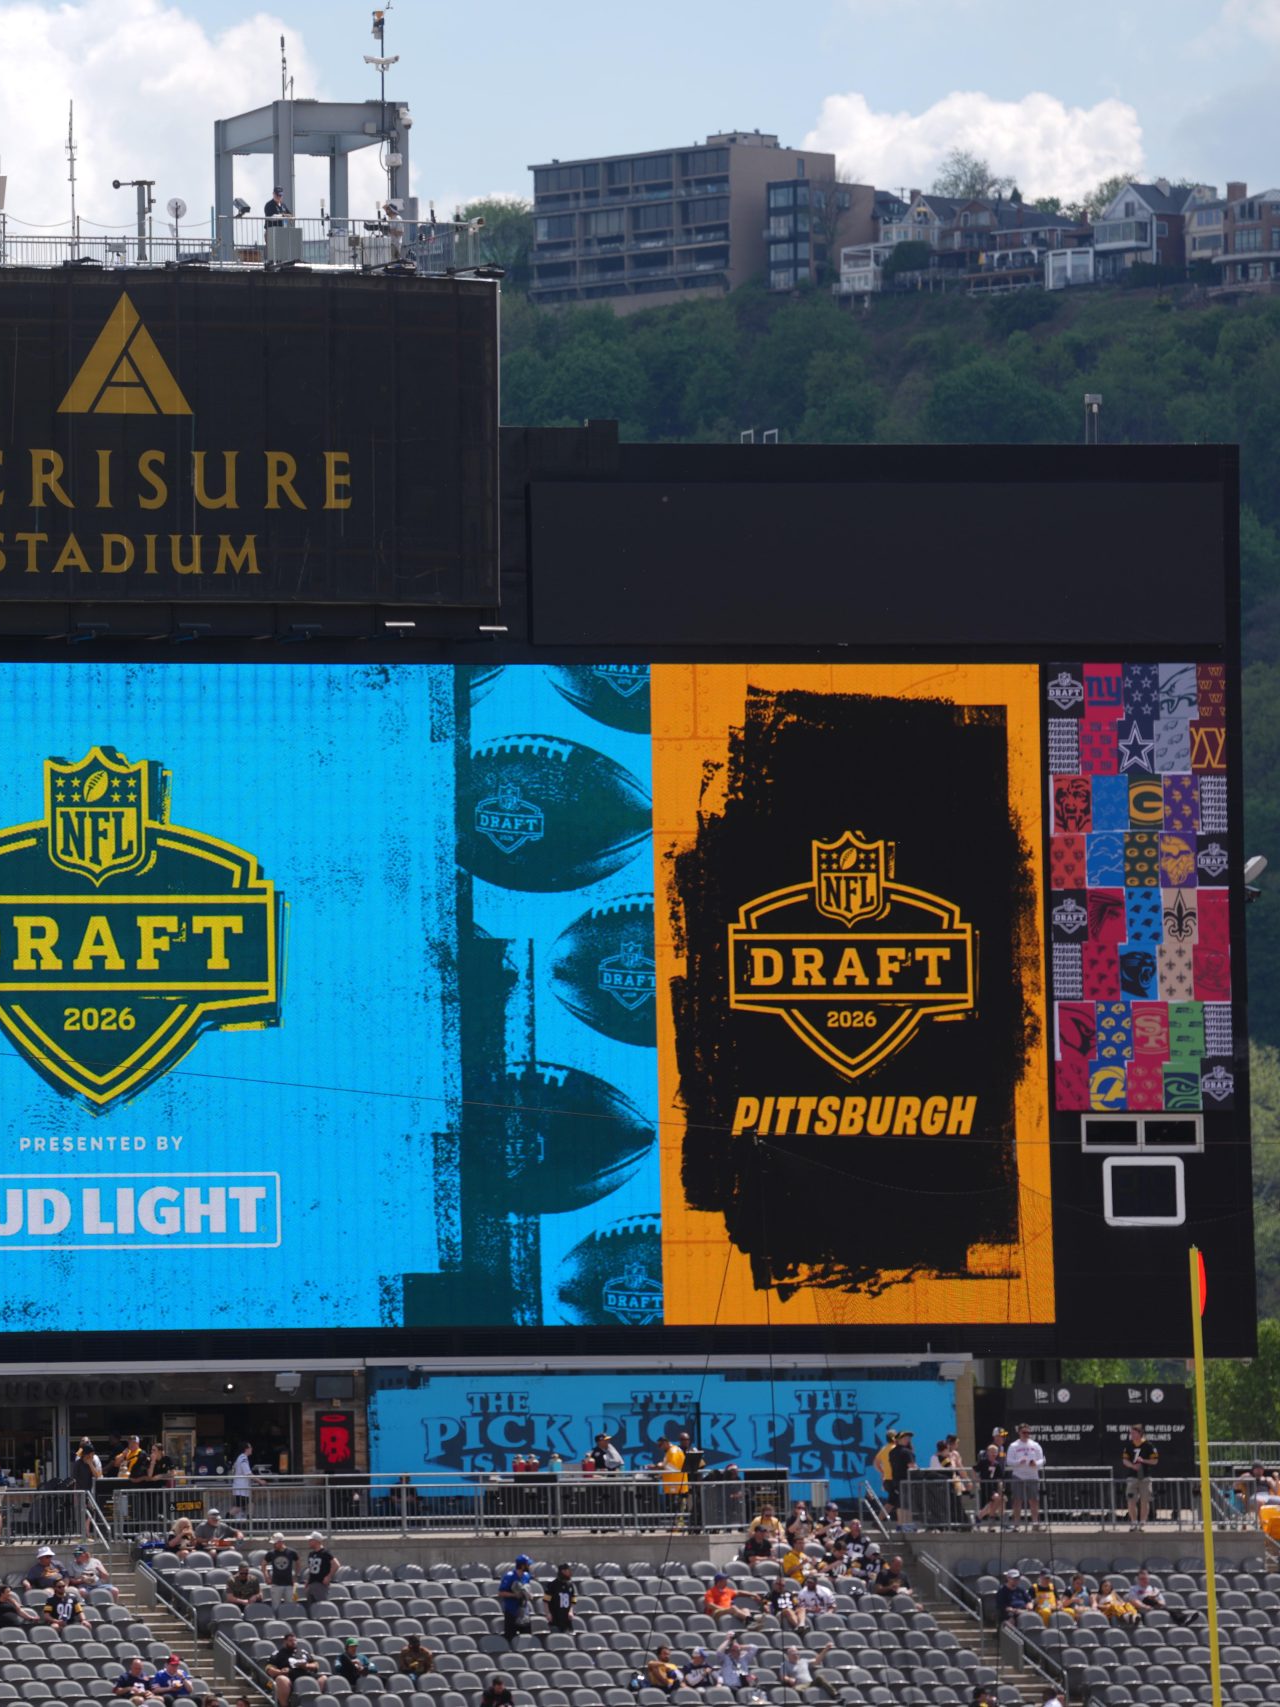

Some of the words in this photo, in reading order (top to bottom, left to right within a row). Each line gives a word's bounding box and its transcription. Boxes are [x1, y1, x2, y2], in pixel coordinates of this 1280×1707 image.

[1049, 689, 1080, 697] DRAFT
[479, 814, 538, 831] DRAFT
[60, 809, 135, 866] NFL
[823, 875, 875, 913] NFL
[750, 947, 951, 986] DRAFT
[63, 1007, 136, 1031] 2026
[827, 1011, 877, 1028] 2026
[731, 1095, 978, 1136] PITTSBURGH
[20, 1136, 147, 1152] PRESENTED
[157, 1136, 183, 1151] BY
[82, 1186, 266, 1235] LIGHT
[607, 1294, 663, 1308] DRAFT
[466, 1391, 530, 1414] THE
[629, 1390, 693, 1413] THE
[795, 1389, 858, 1412] THE
[422, 1413, 573, 1461] PICK
[750, 1411, 900, 1458] PICK
[1081, 1424, 1094, 1432] CAP
[790, 1450, 821, 1473] IS
[832, 1451, 868, 1474] IN
